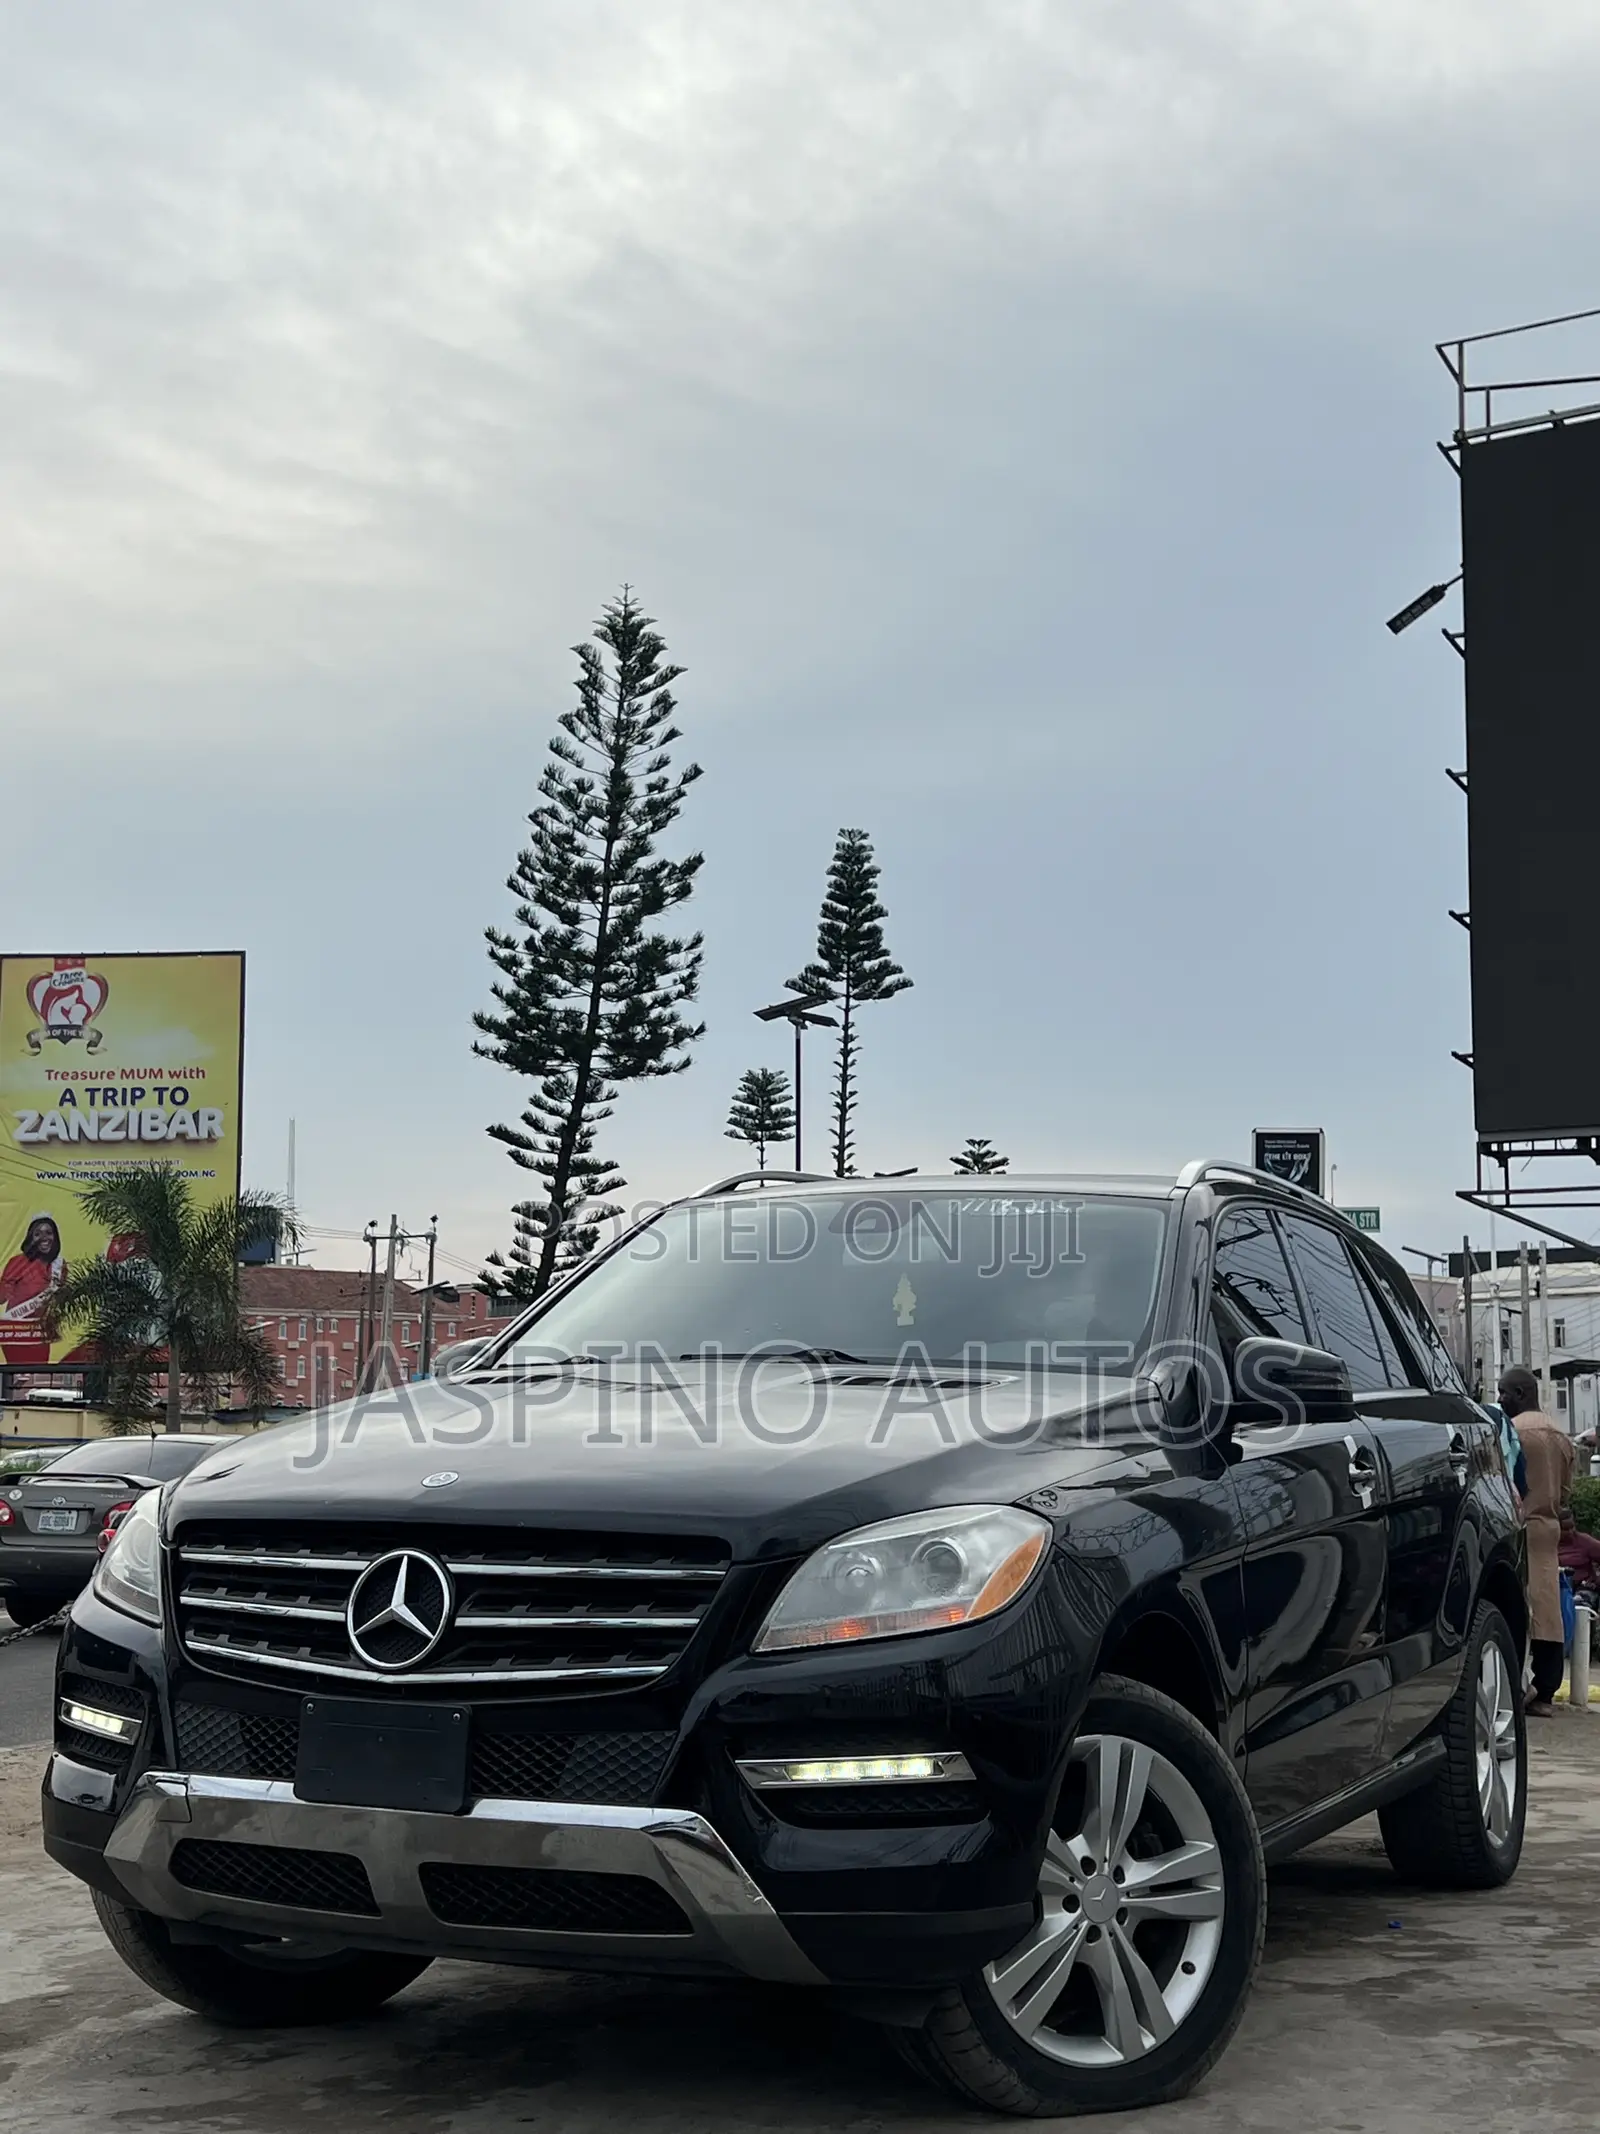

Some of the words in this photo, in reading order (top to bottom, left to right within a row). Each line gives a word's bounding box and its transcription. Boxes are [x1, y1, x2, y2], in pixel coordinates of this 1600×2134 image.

[45, 1069, 116, 1081] Treasure
[120, 1068, 164, 1080] MUM
[168, 1067, 206, 1080] with
[58, 1087, 77, 1107] A
[85, 1086, 146, 1106] TRIP
[153, 1086, 190, 1105] TO
[12, 1107, 225, 1144] ZANZIBAR
[1359, 1212, 1377, 1228] STR
